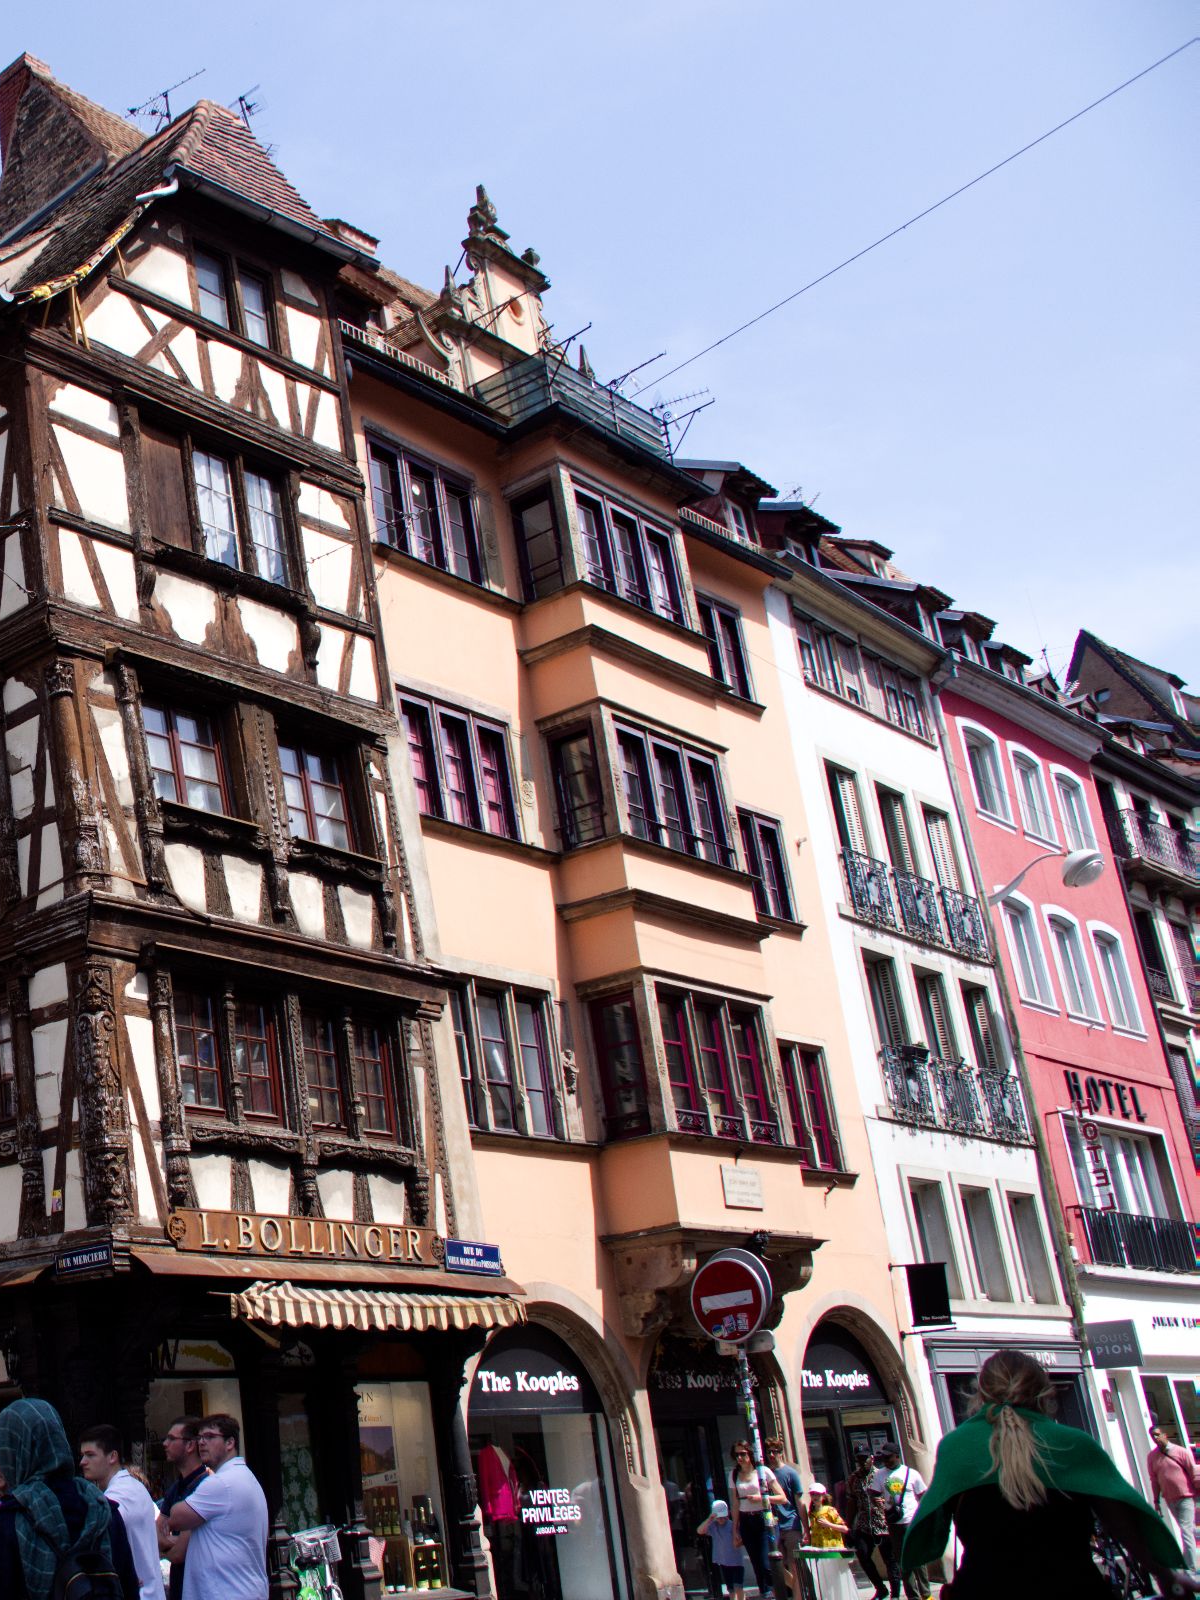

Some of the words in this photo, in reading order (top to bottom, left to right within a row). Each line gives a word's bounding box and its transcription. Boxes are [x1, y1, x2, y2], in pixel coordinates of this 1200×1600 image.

[1063, 1069, 1147, 1123] HOTEL
[236, 1214, 423, 1262] BOLLINGER
[463, 1246, 475, 1256] RUE
[1094, 1332, 1131, 1344] LOUIS
[1095, 1343, 1133, 1356] PION
[477, 1370, 512, 1393] The
[515, 1370, 580, 1396] Kooples
[800, 1369, 824, 1388] The
[824, 1369, 870, 1391] Kooples
[528, 1488, 570, 1505] VENTES
